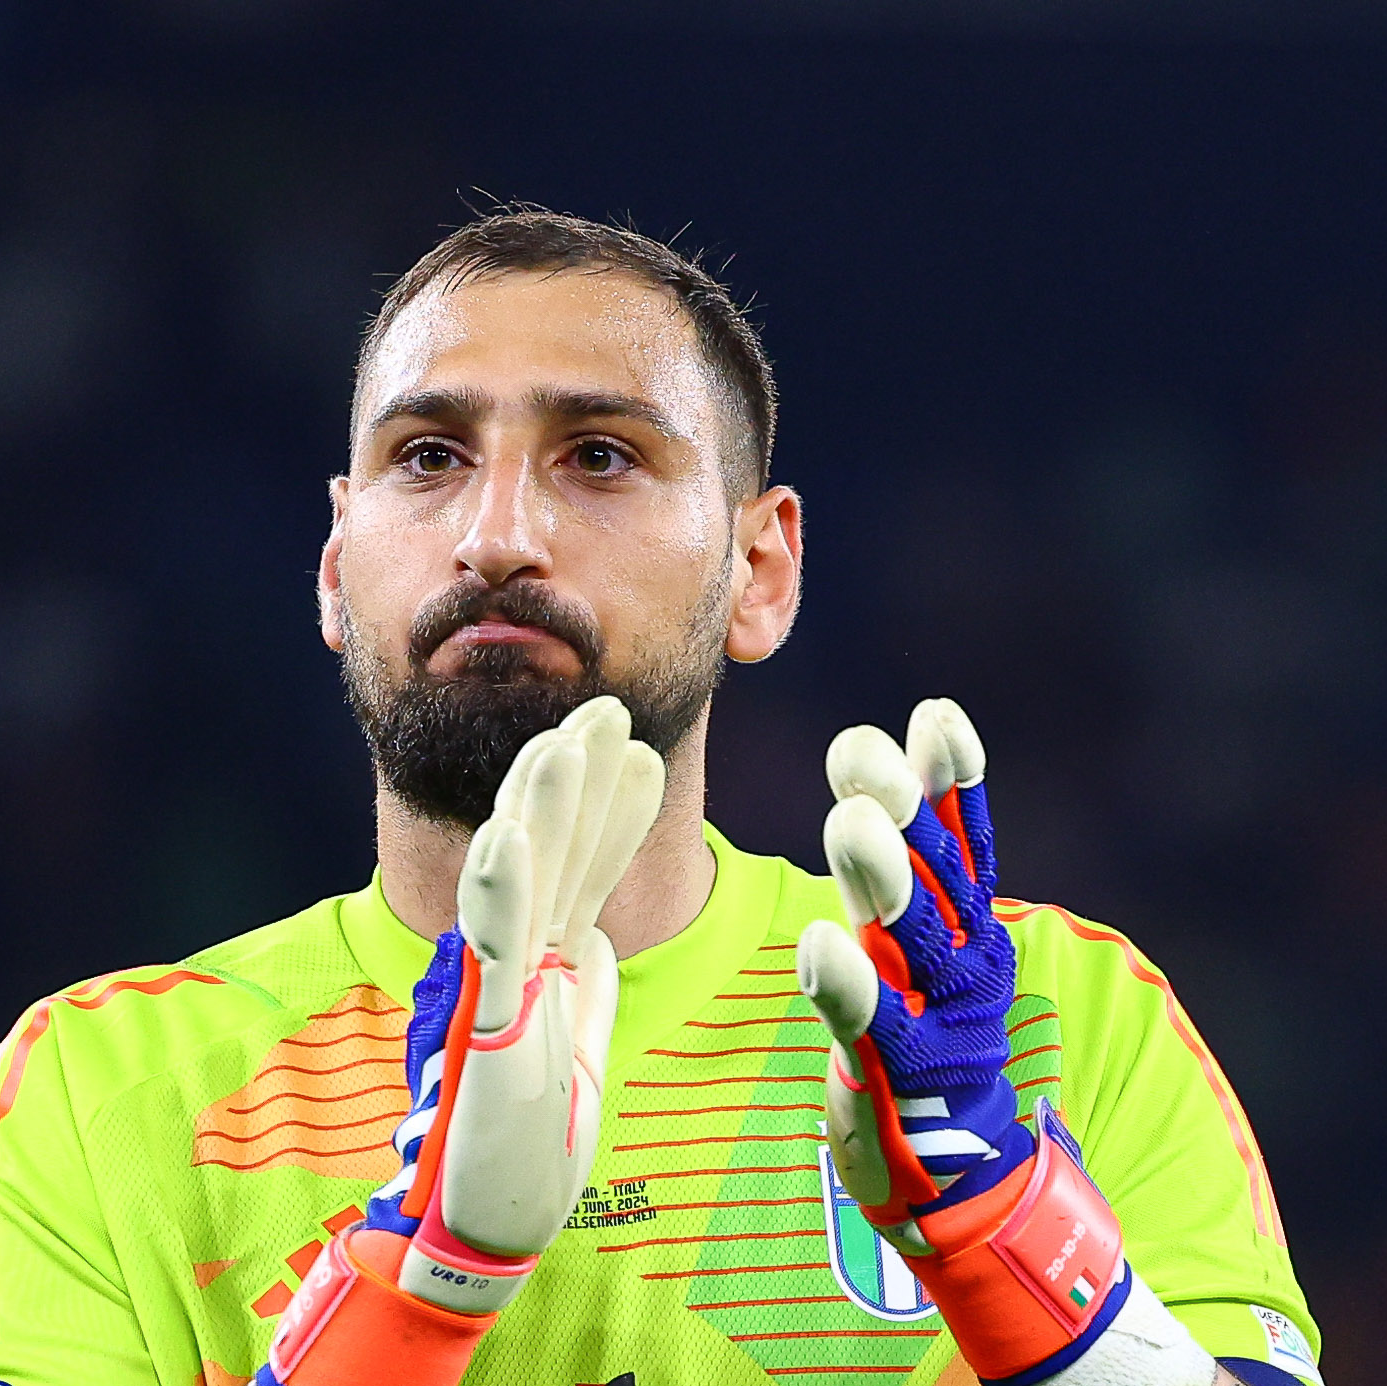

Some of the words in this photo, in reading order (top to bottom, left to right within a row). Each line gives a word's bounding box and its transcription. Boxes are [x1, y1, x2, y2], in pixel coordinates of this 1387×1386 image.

[614, 1180, 646, 1197] ITALY
[582, 1200, 613, 1213] JUNE
[617, 1196, 649, 1211] 2024
[563, 1208, 657, 1230] ELSENKIRCHEN
